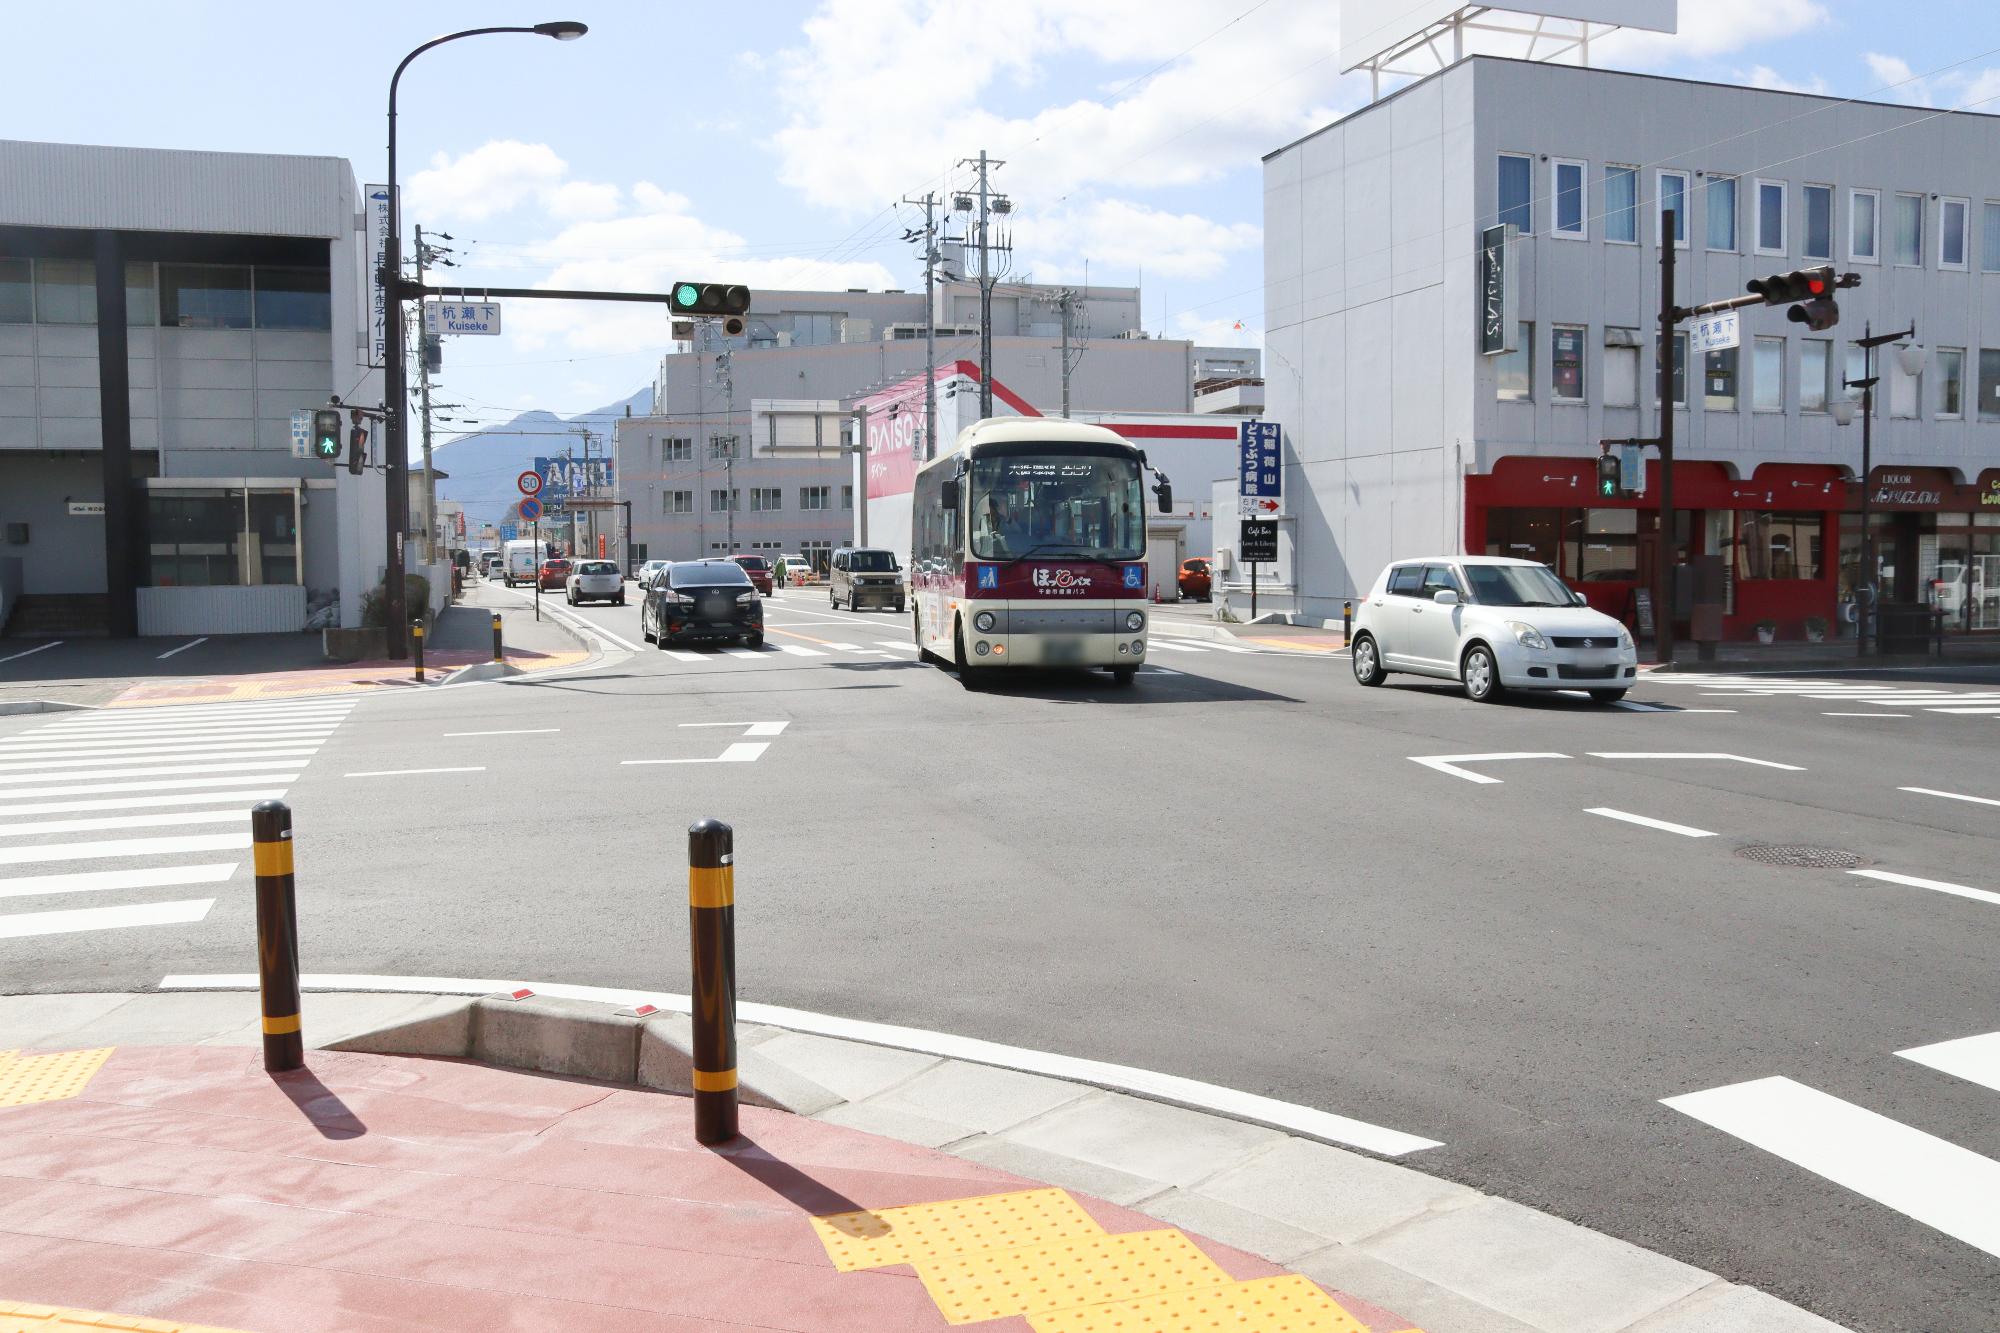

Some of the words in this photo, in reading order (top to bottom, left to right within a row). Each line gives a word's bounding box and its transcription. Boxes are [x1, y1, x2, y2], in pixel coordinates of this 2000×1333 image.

[442, 305, 495, 320] 杭瀬下
[448, 321, 488, 331] Kuiseke
[870, 413, 913, 456] DAISO
[1245, 424, 1258, 495] どうぶつ病院
[523, 477, 537, 489] 50
[1882, 475, 1912, 485] LIQUOR
